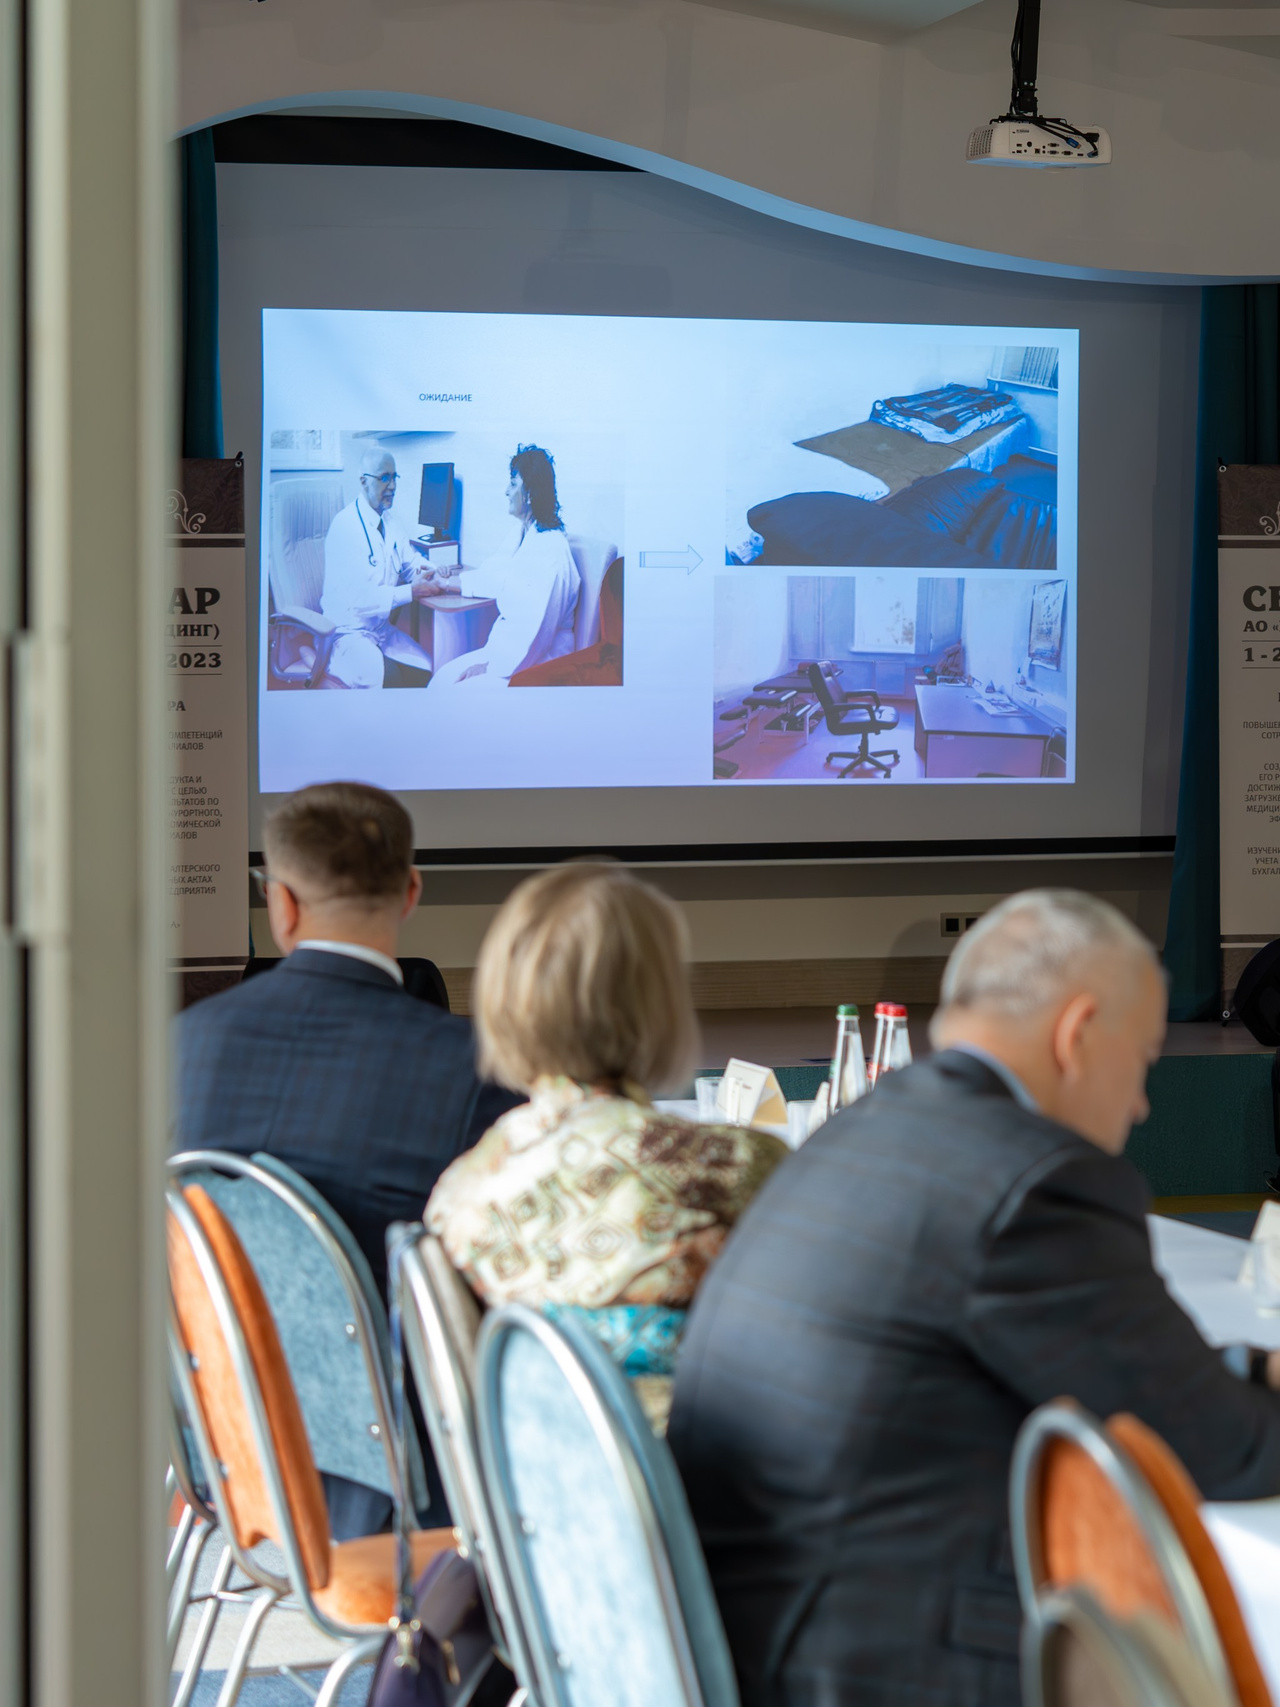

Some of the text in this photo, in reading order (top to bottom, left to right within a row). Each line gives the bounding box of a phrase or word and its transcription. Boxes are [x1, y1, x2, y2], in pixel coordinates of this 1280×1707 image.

[418, 393, 473, 403] ОЖИДАНИЕ
[1243, 620, 1268, 633] АО
[1244, 647, 1254, 662] 1
[168, 730, 223, 740] ОМПЕТЕНЦИЙ
[1259, 773, 1273, 781] ЕГО
[178, 786, 207, 795] ЦЕЛЬЮ
[207, 797, 219, 806] ПО
[187, 875, 213, 884] АКТАХ
